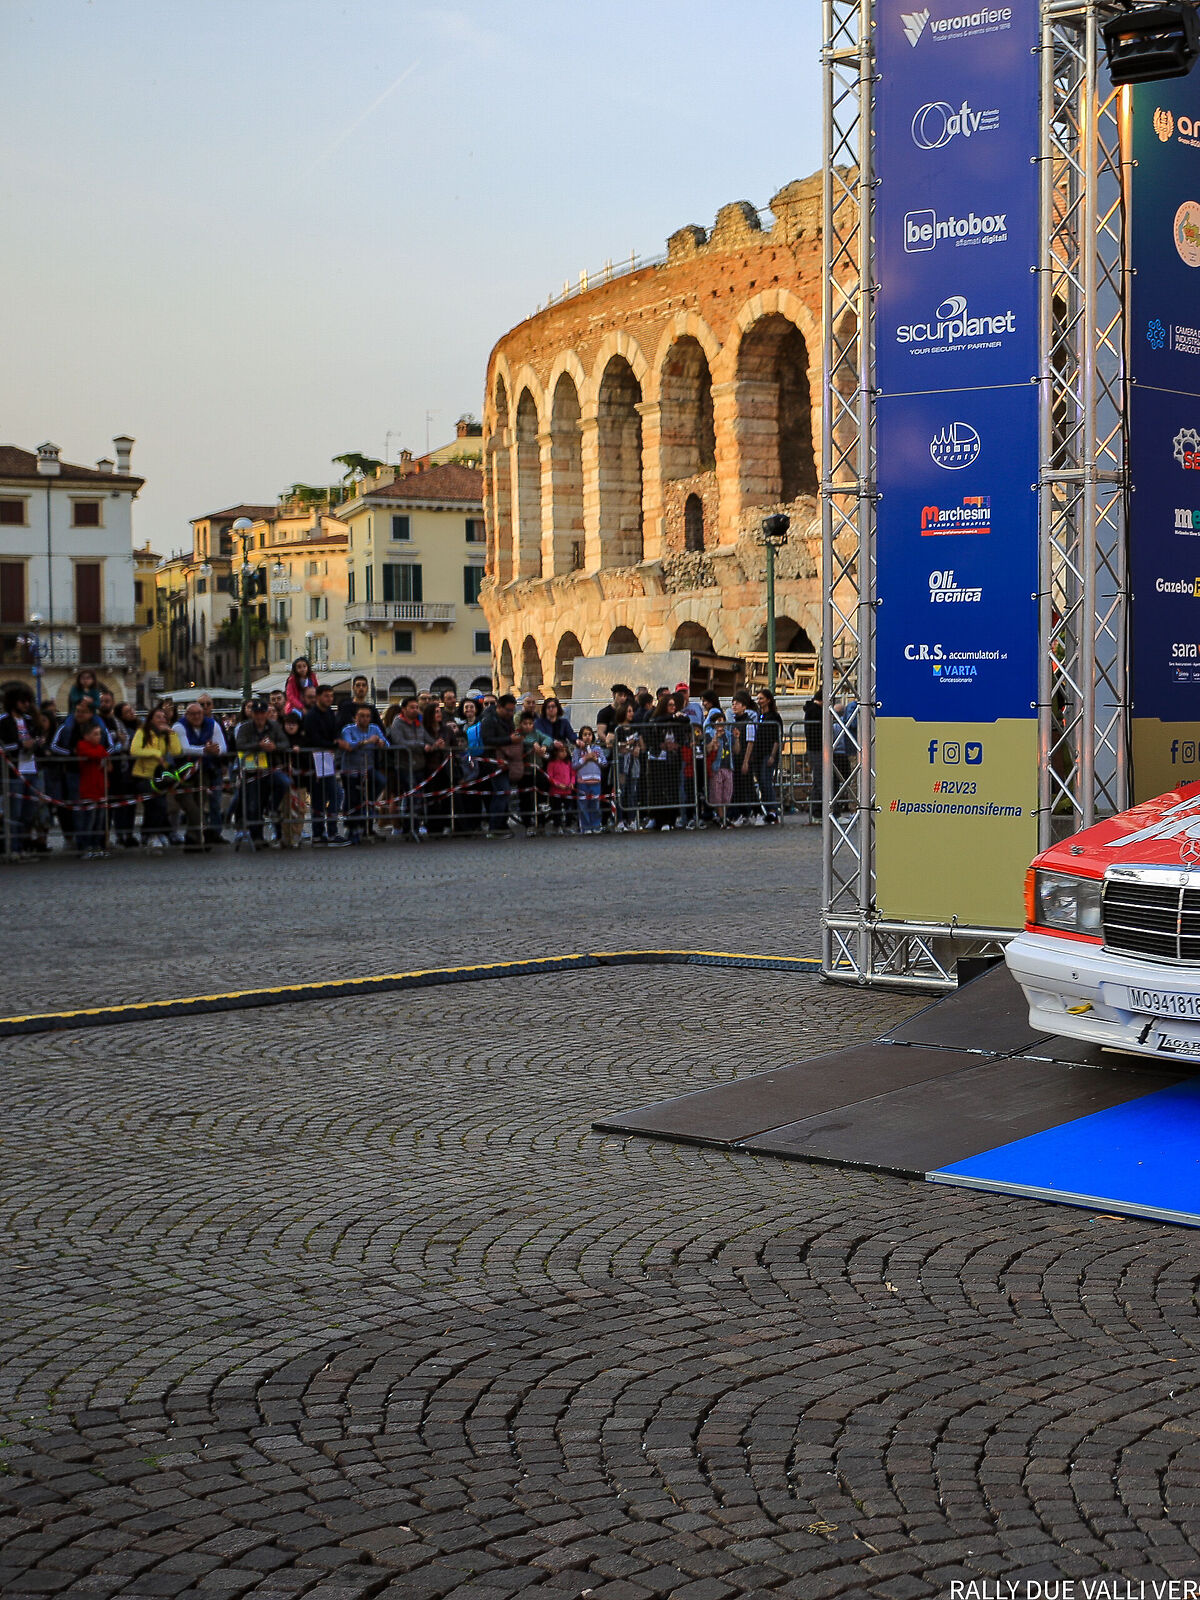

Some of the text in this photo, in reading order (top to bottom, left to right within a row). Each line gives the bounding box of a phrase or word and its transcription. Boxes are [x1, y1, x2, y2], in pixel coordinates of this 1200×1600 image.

[930, 8, 1012, 33] veronafiere
[947, 100, 982, 138] atv
[907, 213, 1007, 242] bentobox
[896, 309, 1016, 343] sicurplanet
[1175, 326, 1197, 337] CAMERA
[931, 344, 966, 353] SECURITY
[967, 341, 1002, 350] PARTNER
[936, 454, 976, 462] events
[921, 506, 991, 529] Marchesini
[929, 588, 982, 603] Tecnica
[904, 644, 947, 660] C.R.S.
[949, 650, 999, 660] accumulatori
[1172, 642, 1197, 658] sara
[944, 665, 977, 676] VARTA
[933, 781, 977, 794] #R2V23
[889, 799, 1023, 817] #lapassionenonsiferma
